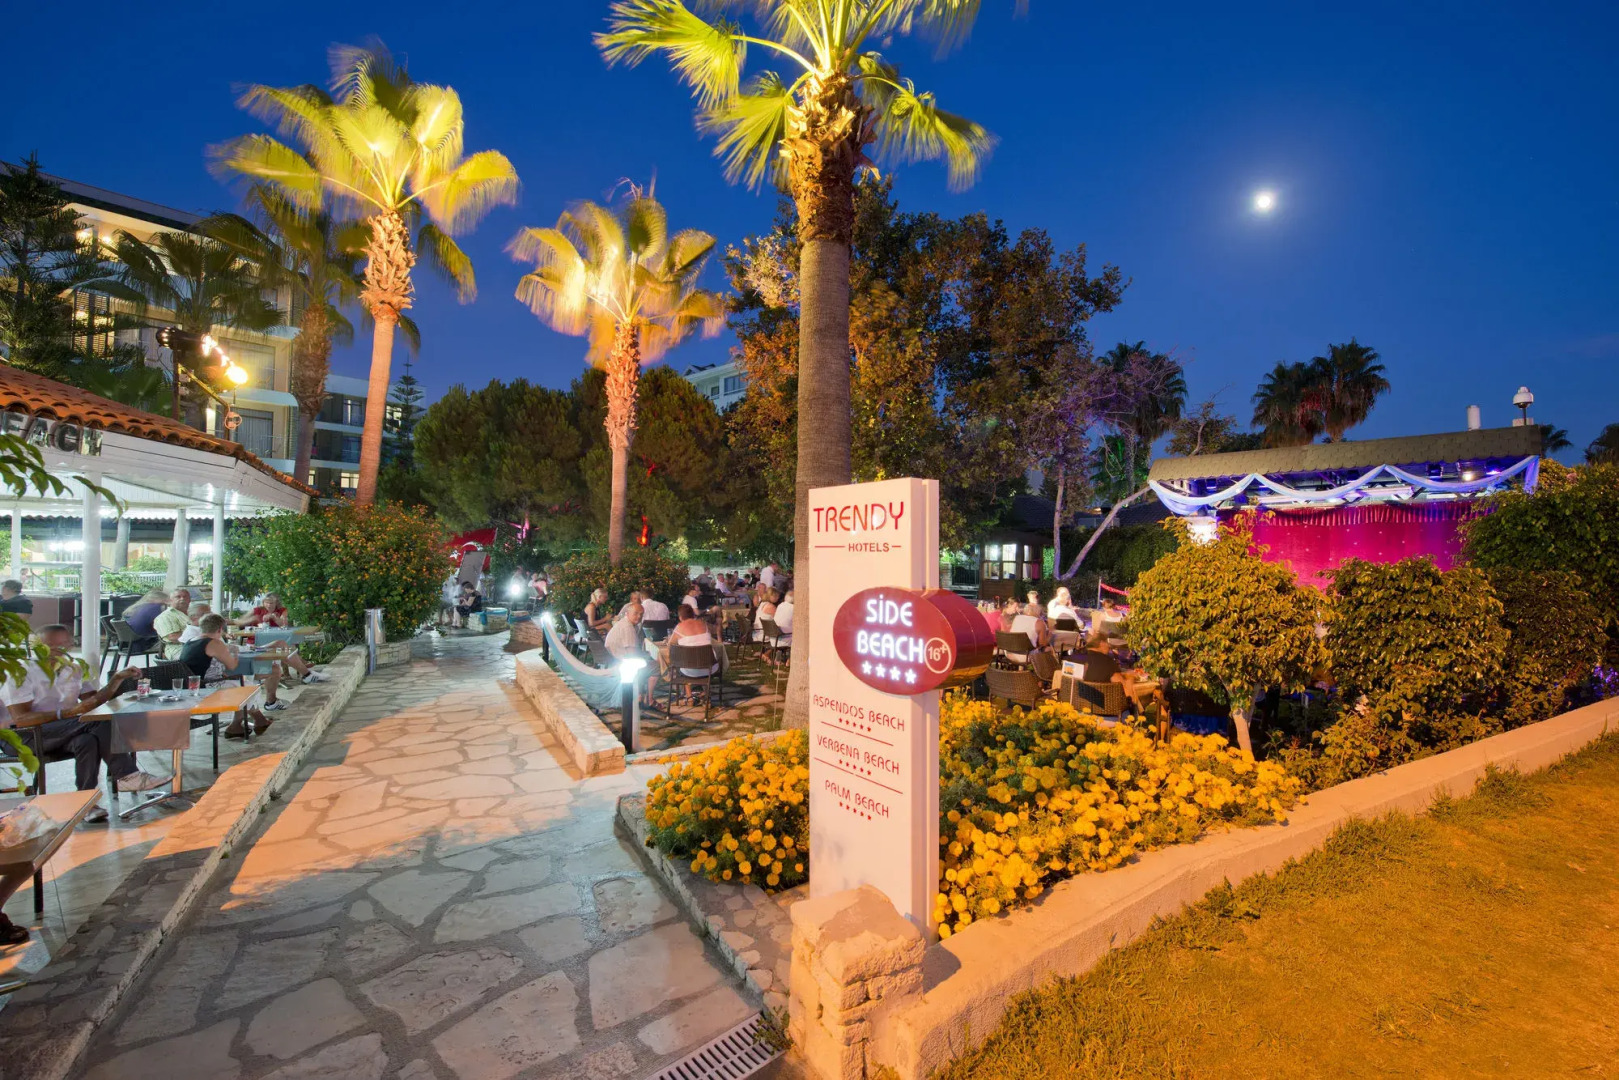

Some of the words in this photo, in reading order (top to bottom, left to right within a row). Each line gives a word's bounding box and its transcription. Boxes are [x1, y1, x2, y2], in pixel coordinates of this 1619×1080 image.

[813, 501, 904, 532] TRENDY
[848, 542, 890, 552] HOTELS
[856, 629, 925, 664] BEACH
[927, 644, 948, 662] 16+
[812, 694, 865, 720] ASPENDOS
[868, 710, 905, 732] BEACH
[816, 733, 860, 761] VERBENA
[863, 751, 900, 775] BEACH
[824, 779, 851, 801] PALM
[854, 792, 889, 819] BEACH
